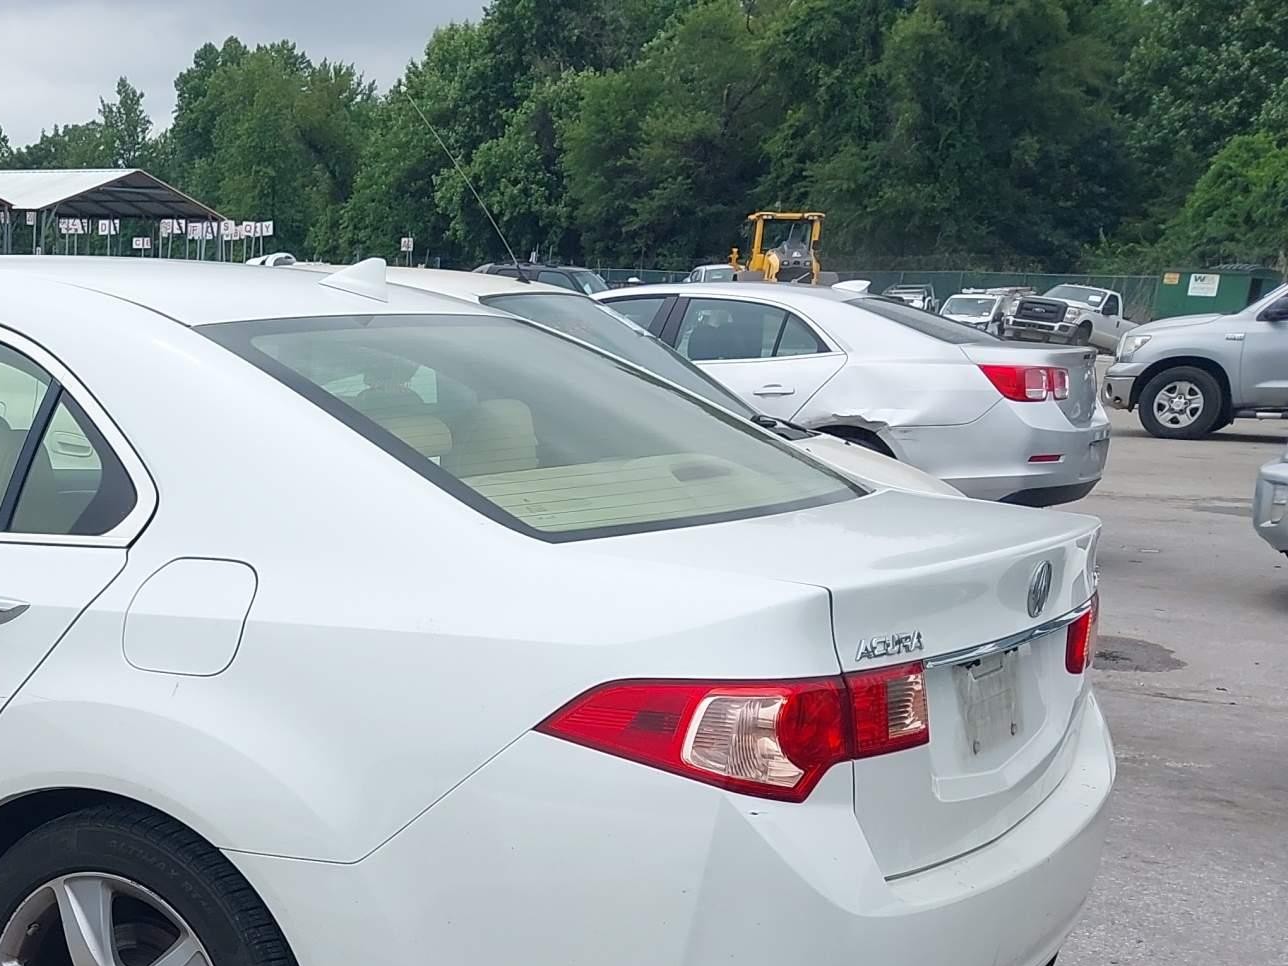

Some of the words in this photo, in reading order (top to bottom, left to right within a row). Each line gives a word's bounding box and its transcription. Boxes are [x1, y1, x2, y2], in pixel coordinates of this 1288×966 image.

[100, 222, 107, 233] D
[223, 222, 230, 231] S
[244, 223, 253, 234] Q
[264, 223, 271, 233] Y
[855, 630, 924, 661] ACURA
